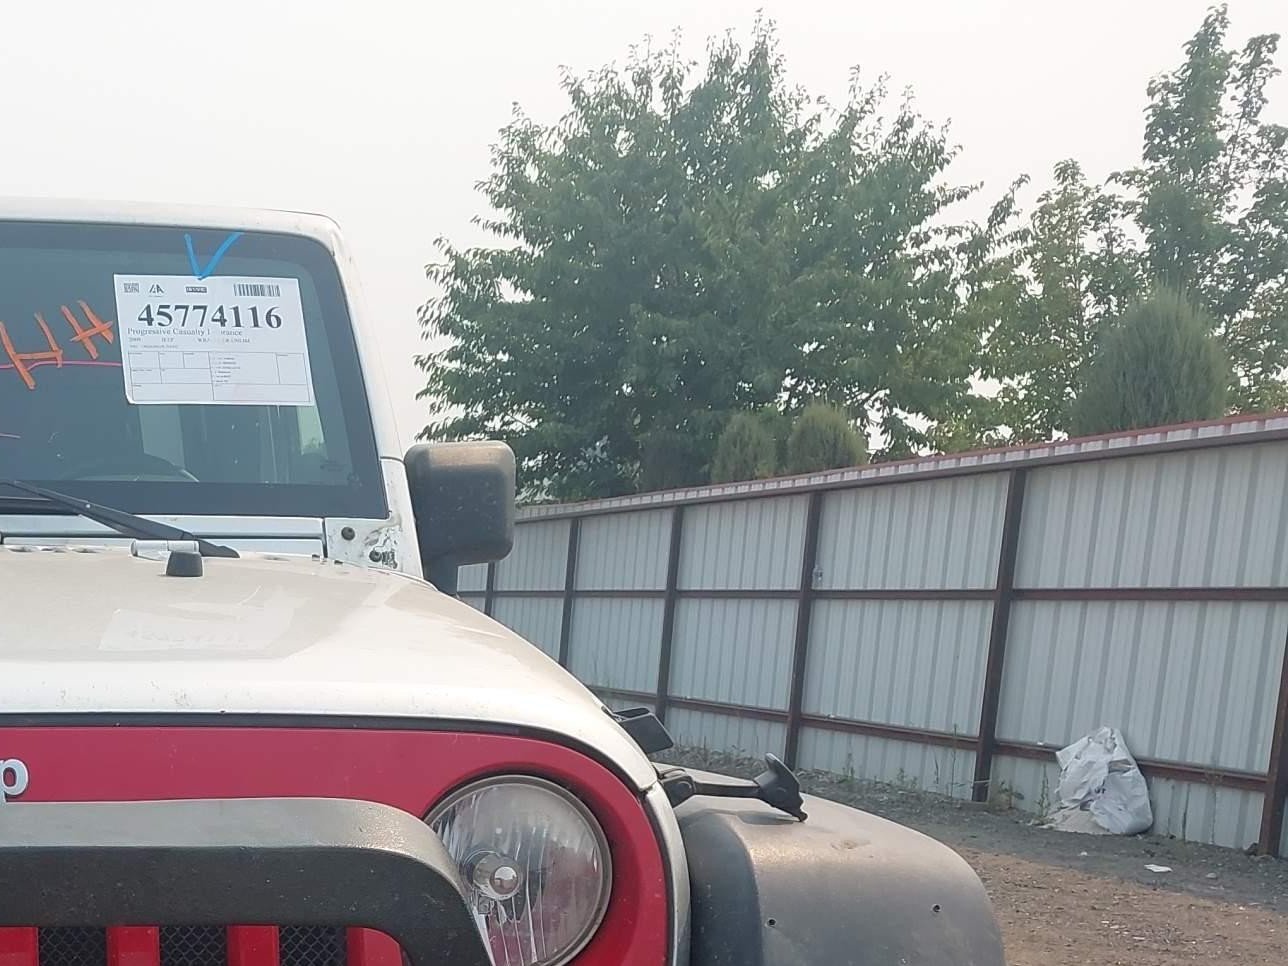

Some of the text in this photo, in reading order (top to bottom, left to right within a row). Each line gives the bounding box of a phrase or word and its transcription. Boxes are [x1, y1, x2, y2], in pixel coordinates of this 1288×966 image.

[137, 303, 282, 329] 45774116
[127, 328, 171, 336] Progressive
[173, 328, 205, 336] Casualty
